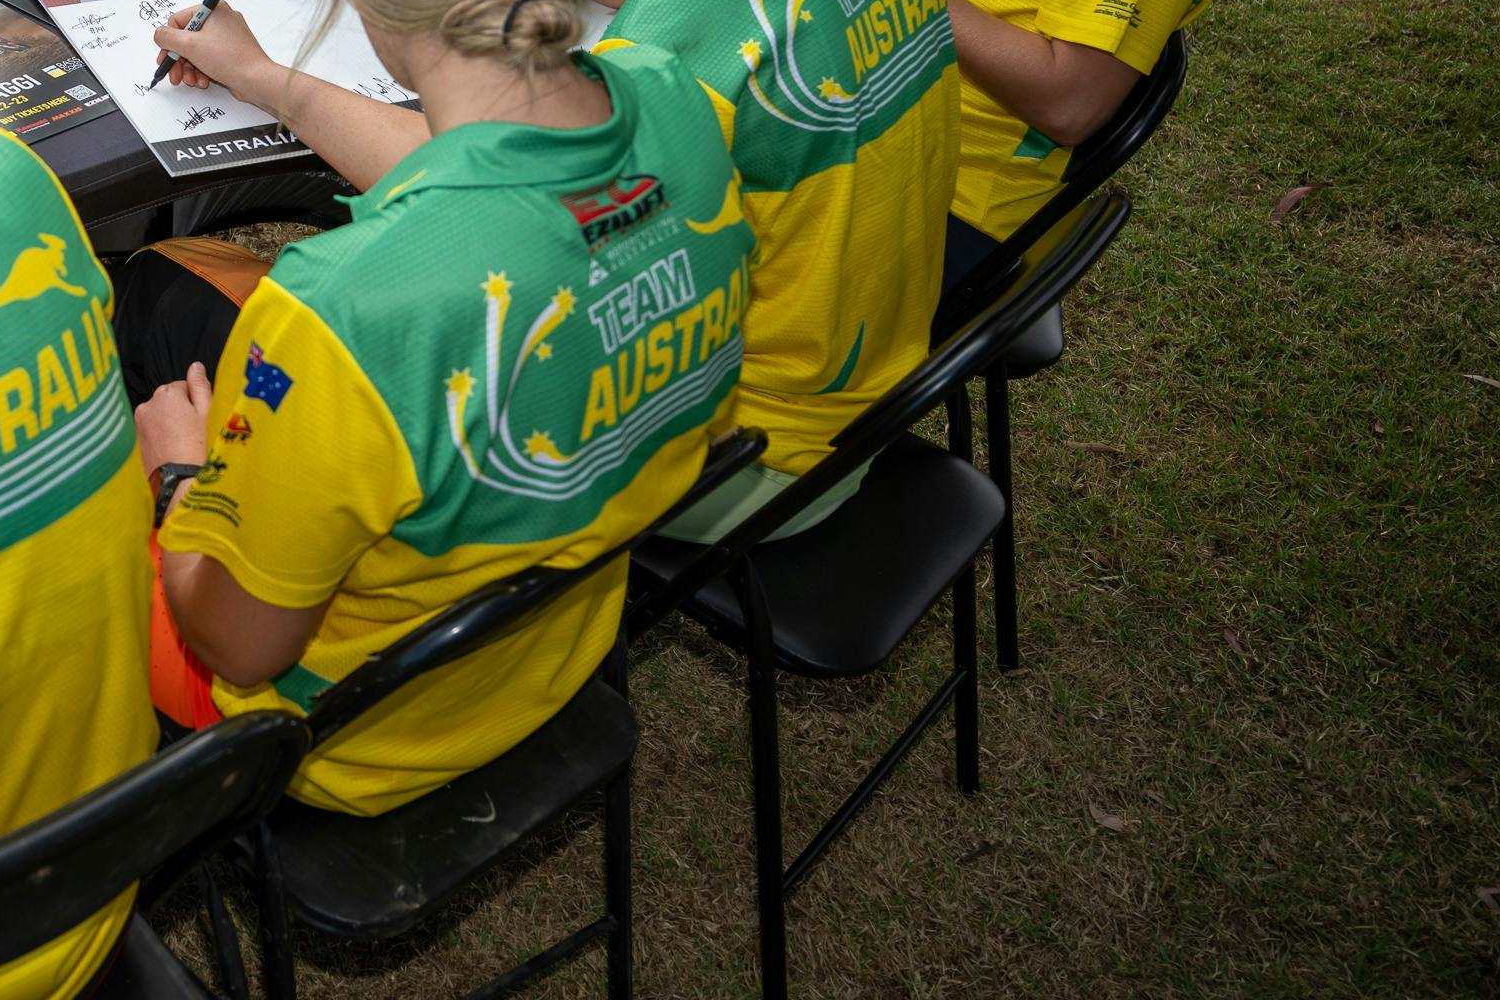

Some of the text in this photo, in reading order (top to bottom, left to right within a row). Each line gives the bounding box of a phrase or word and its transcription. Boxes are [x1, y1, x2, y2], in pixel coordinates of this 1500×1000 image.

[0, 114, 16, 125] BUY
[16, 101, 49, 119] TICKETS
[47, 94, 70, 109] HERE
[174, 131, 299, 162] AUSTRALIA
[581, 184, 665, 246] EZILIFT
[587, 248, 696, 356] TEAM
